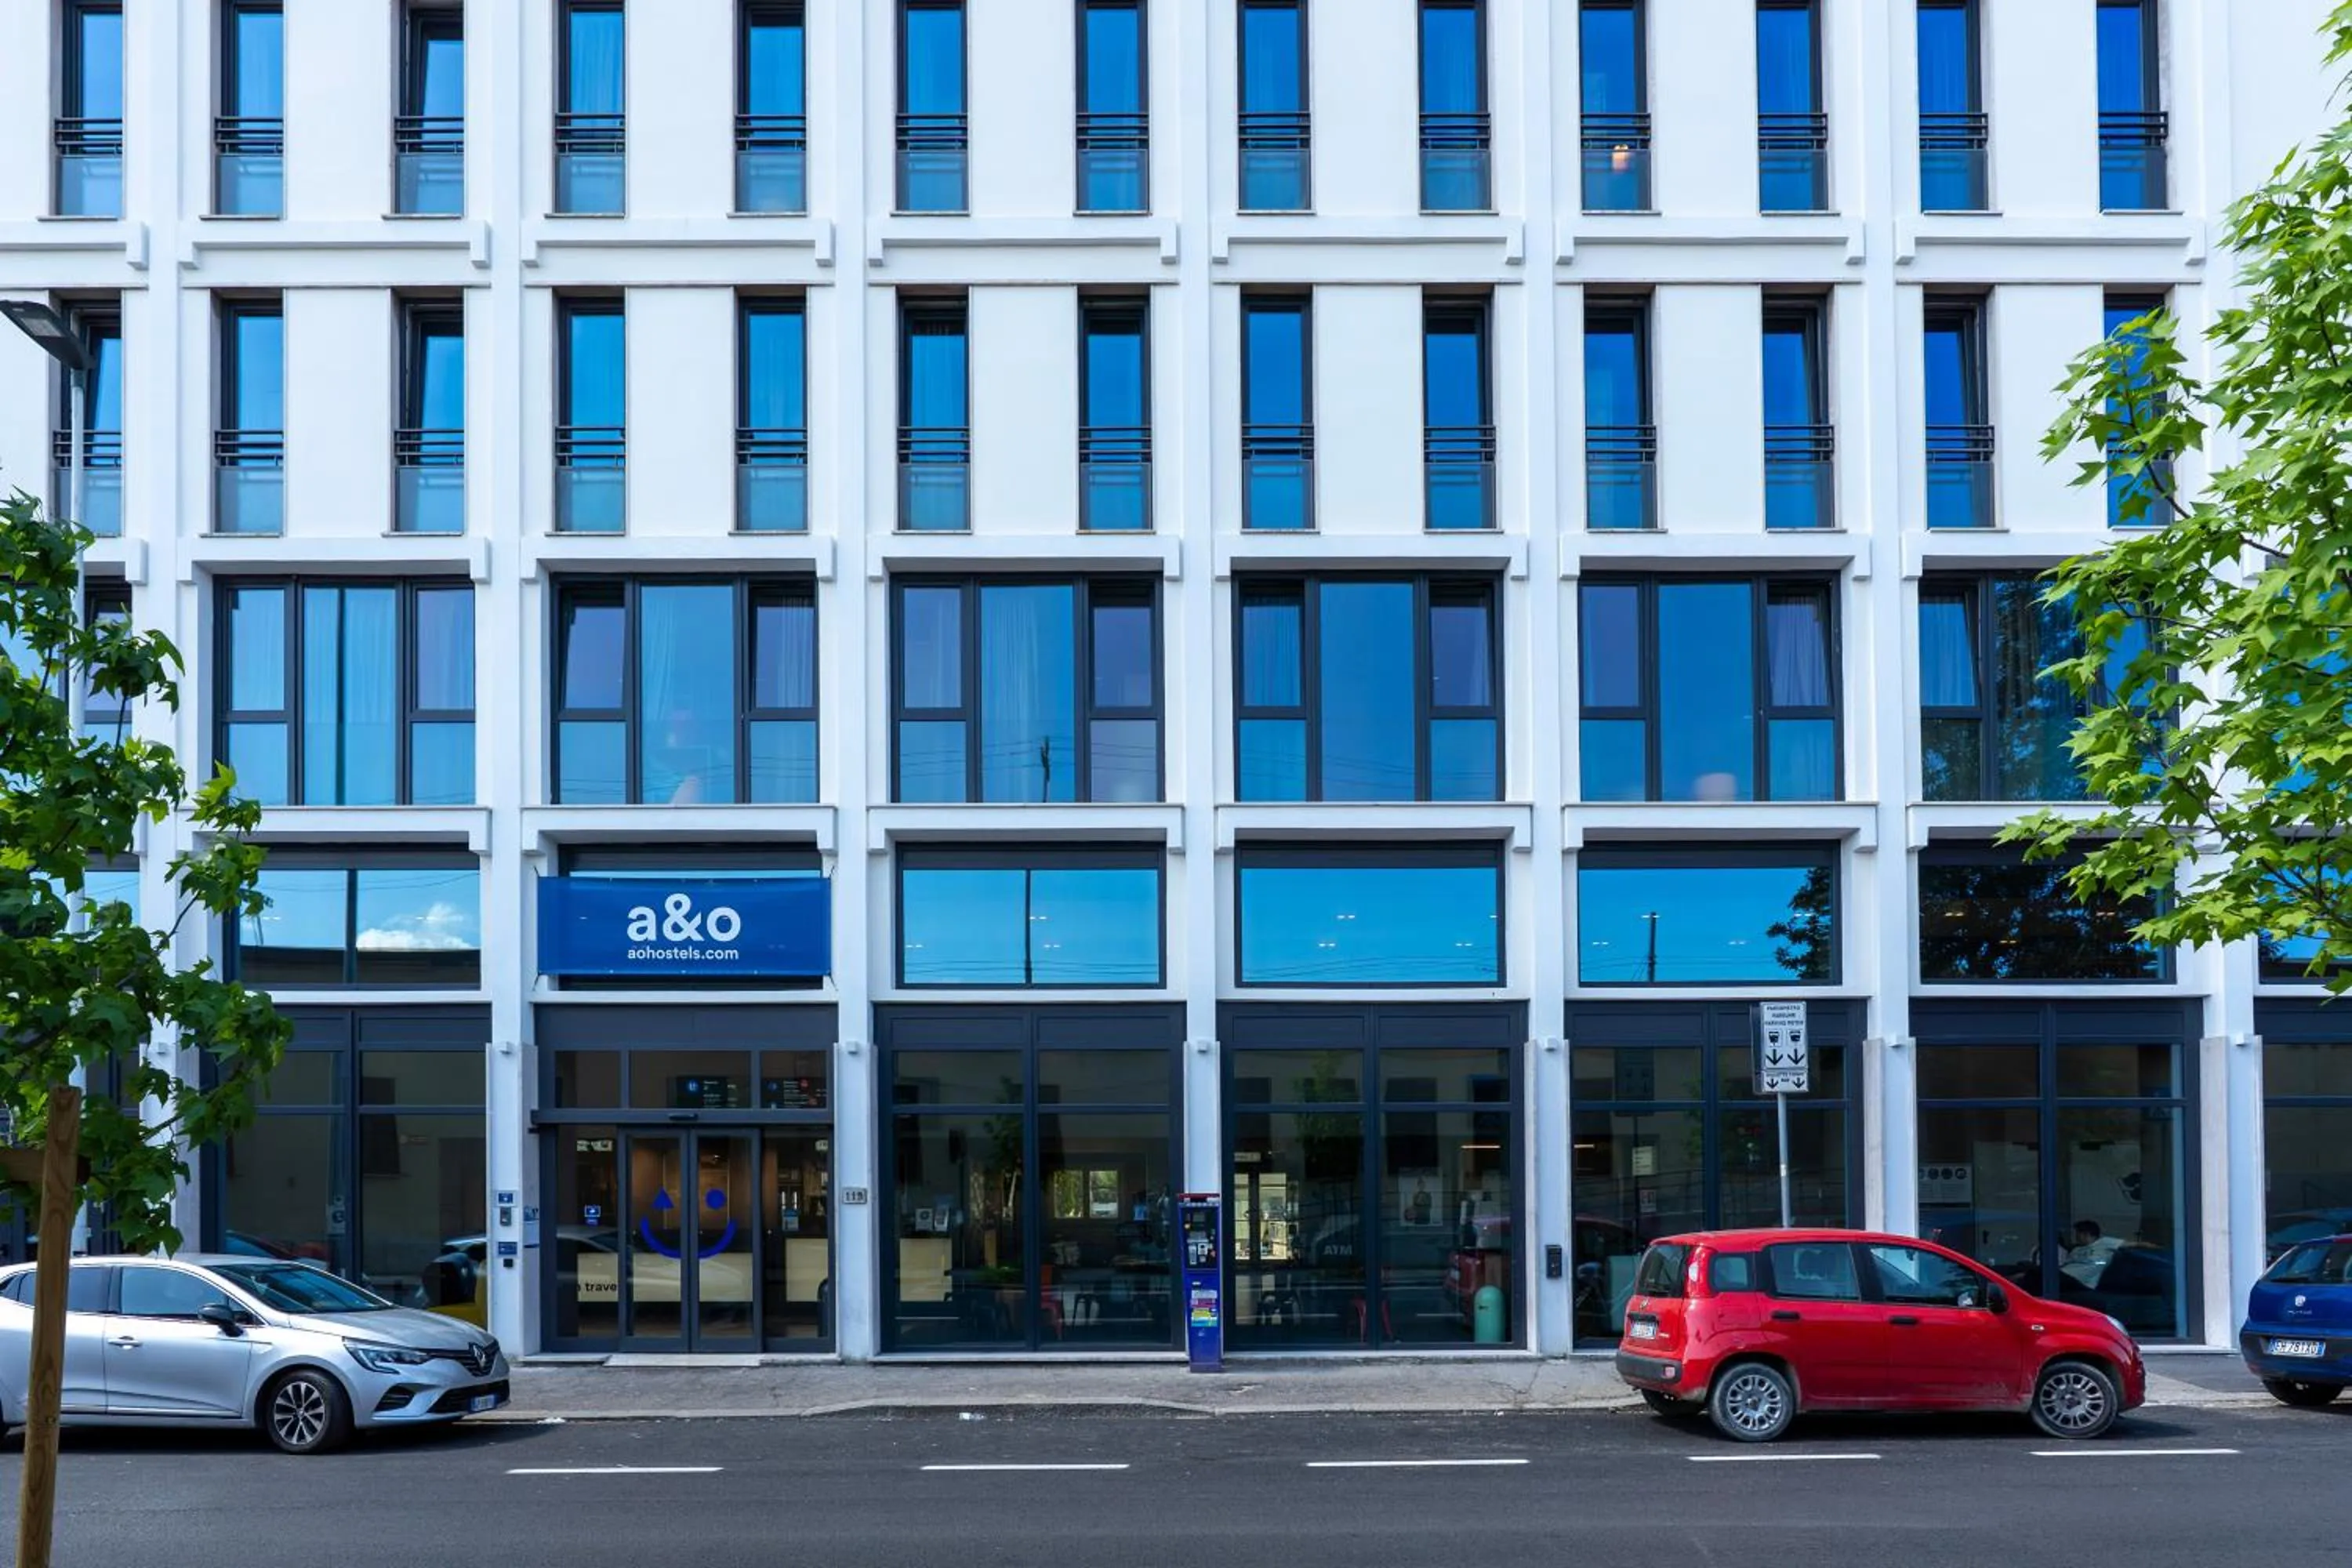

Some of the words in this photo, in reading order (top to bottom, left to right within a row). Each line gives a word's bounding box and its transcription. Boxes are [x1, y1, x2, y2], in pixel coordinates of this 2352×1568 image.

[627, 893, 741, 942] a&o
[627, 946, 739, 960] aohostels.com
[1323, 1244, 1352, 1254] ATM
